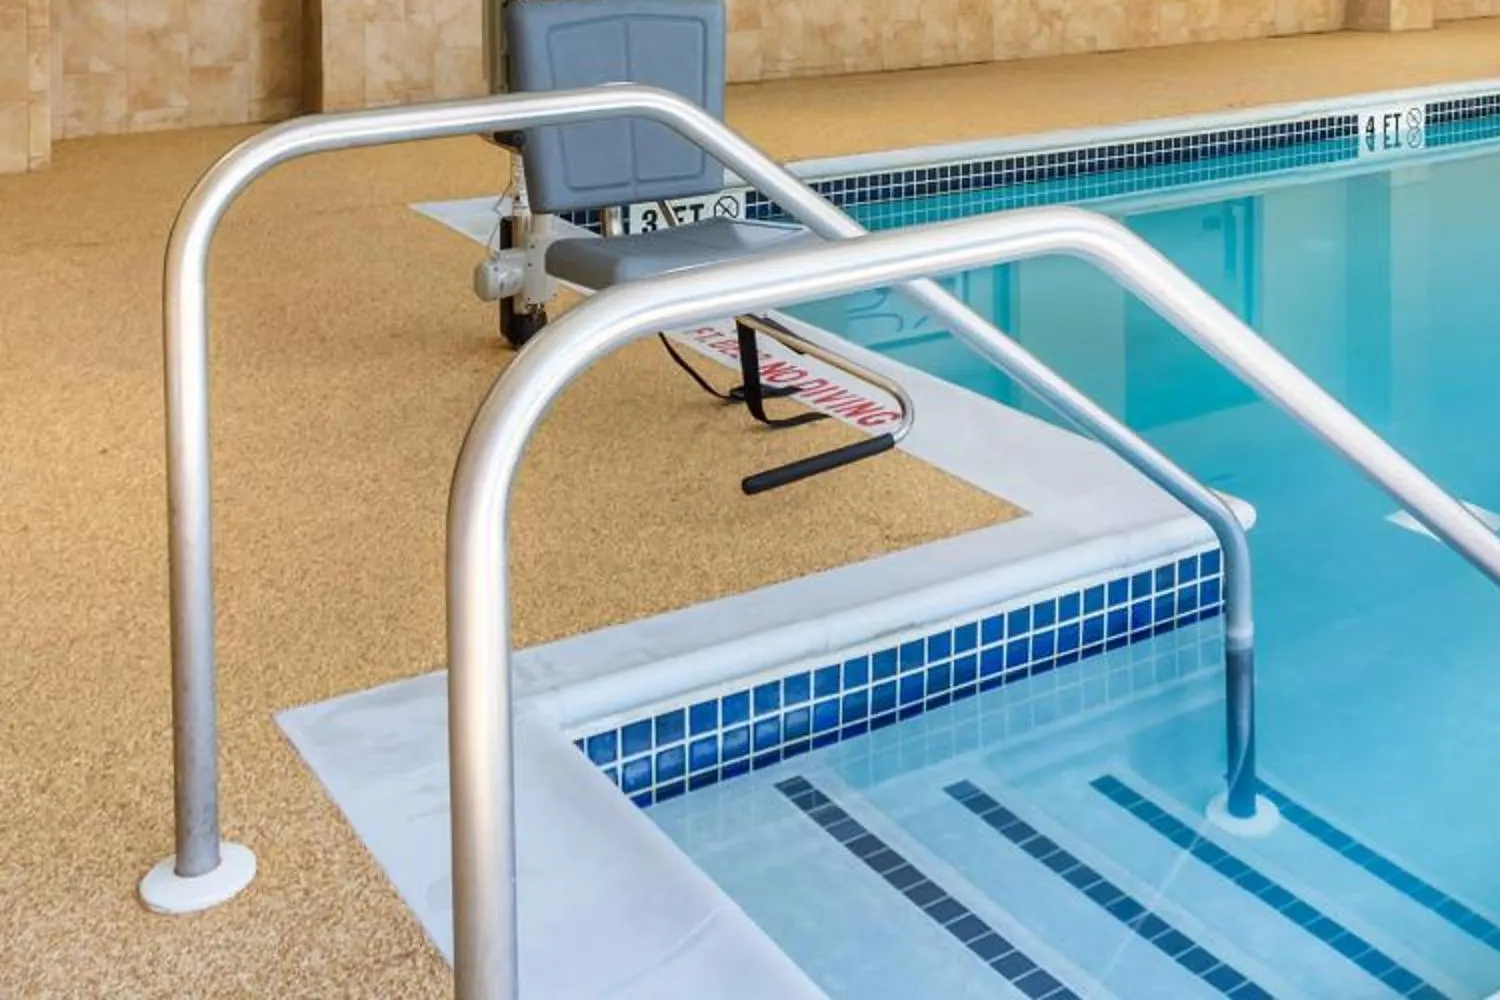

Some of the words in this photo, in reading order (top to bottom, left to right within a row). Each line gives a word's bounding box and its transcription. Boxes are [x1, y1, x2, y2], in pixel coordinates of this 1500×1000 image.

[1383, 112, 1403, 133] FT
[641, 209, 657, 233] 3
[799, 378, 902, 427] DIVING
